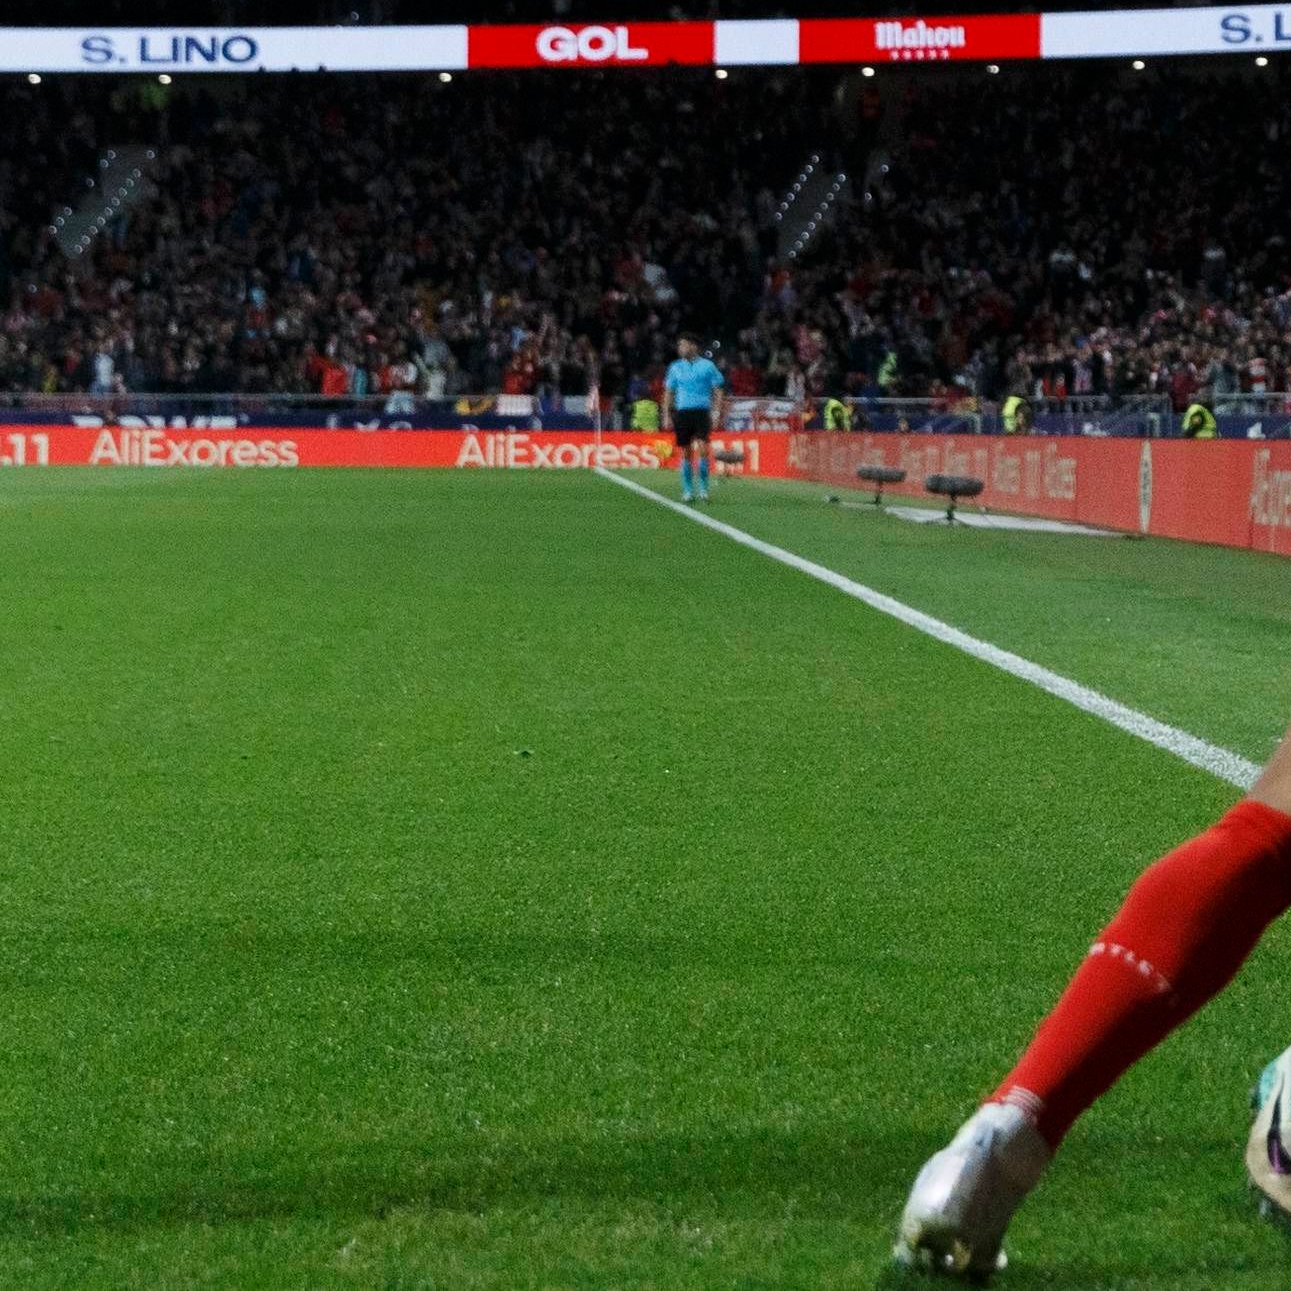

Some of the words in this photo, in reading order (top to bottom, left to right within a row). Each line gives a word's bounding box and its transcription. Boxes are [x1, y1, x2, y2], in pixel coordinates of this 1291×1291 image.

[875, 20, 966, 50] Mahou
[1220, 14, 1263, 43] S.
[81, 36, 126, 65] S.
[139, 36, 258, 64] LINO
[535, 26, 648, 62] GOL
